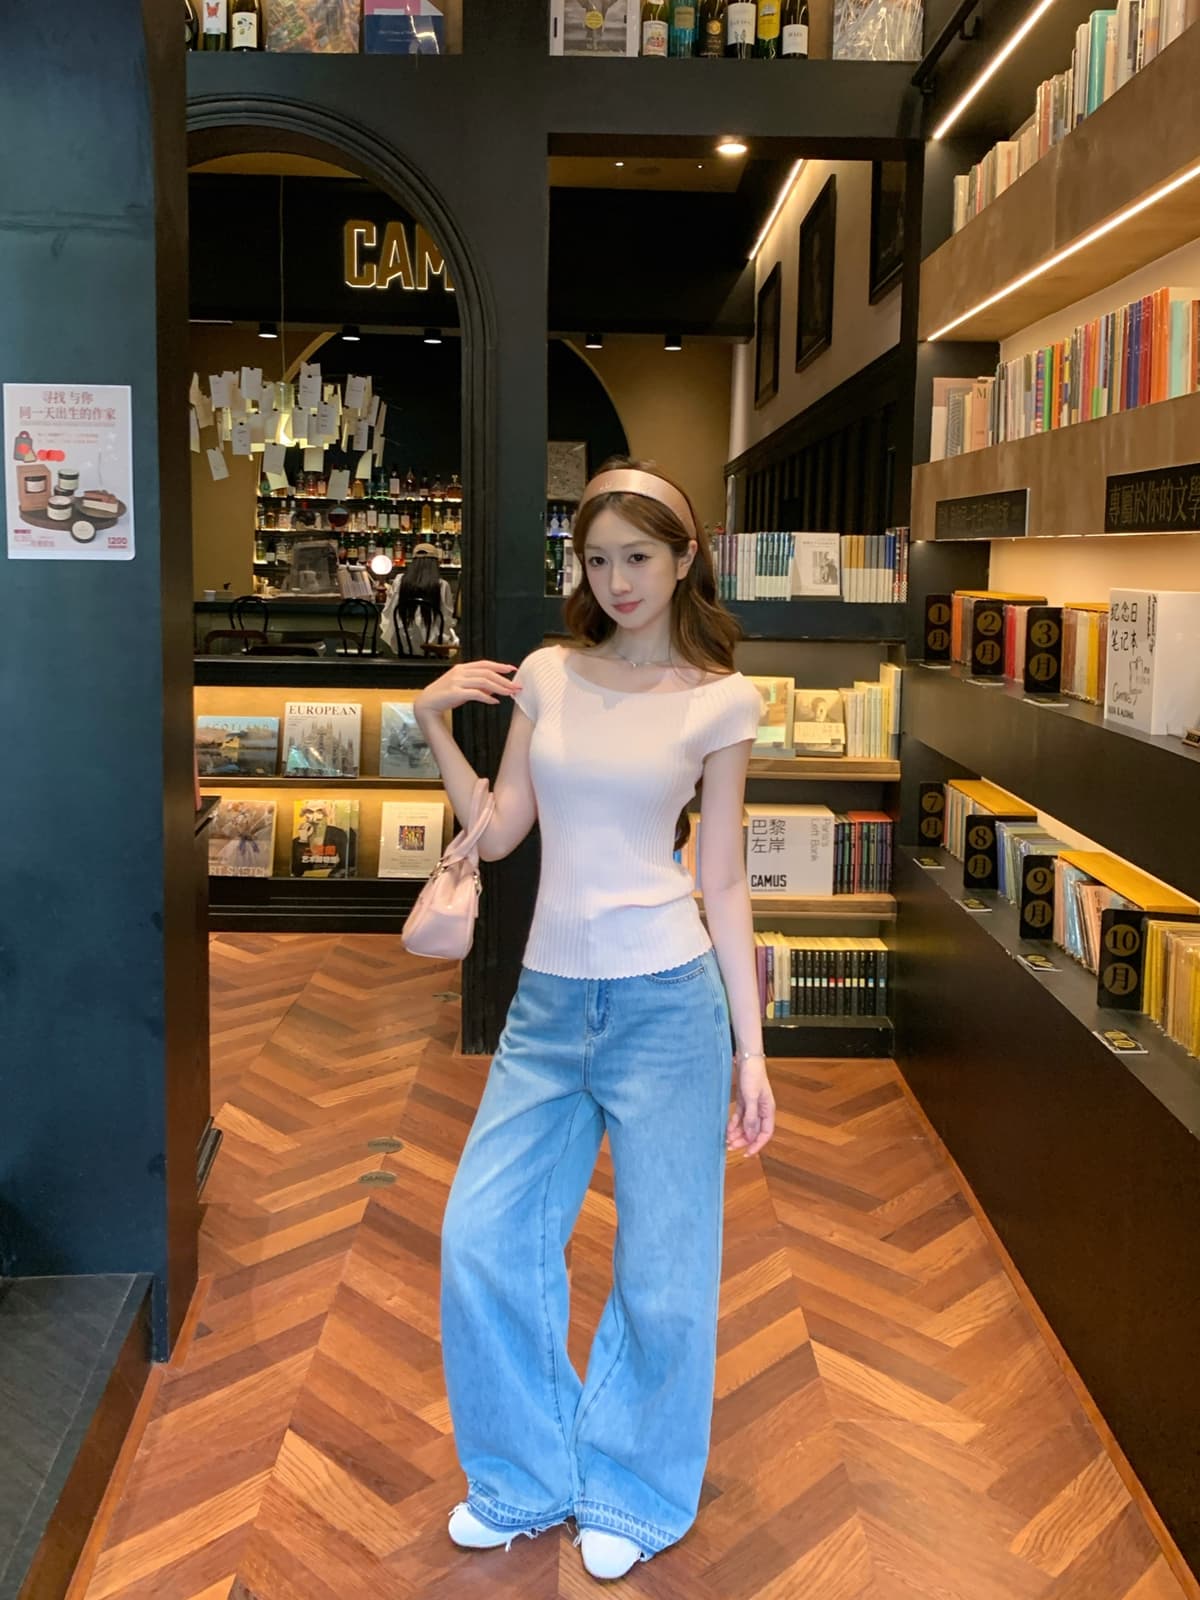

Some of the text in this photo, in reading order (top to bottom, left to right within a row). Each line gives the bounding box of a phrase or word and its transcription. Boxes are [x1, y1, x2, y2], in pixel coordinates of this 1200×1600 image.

[69, 391, 94, 404] 与你
[19, 406, 117, 420] 同一天出生的作家
[1110, 601, 1138, 622] 纪念日
[1111, 629, 1138, 656] 笔记本
[289, 704, 358, 716] EUROPEAN
[751, 818, 787, 836] 巴黎
[751, 837, 785, 854] 左岸
[751, 874, 787, 888] CAMUS
